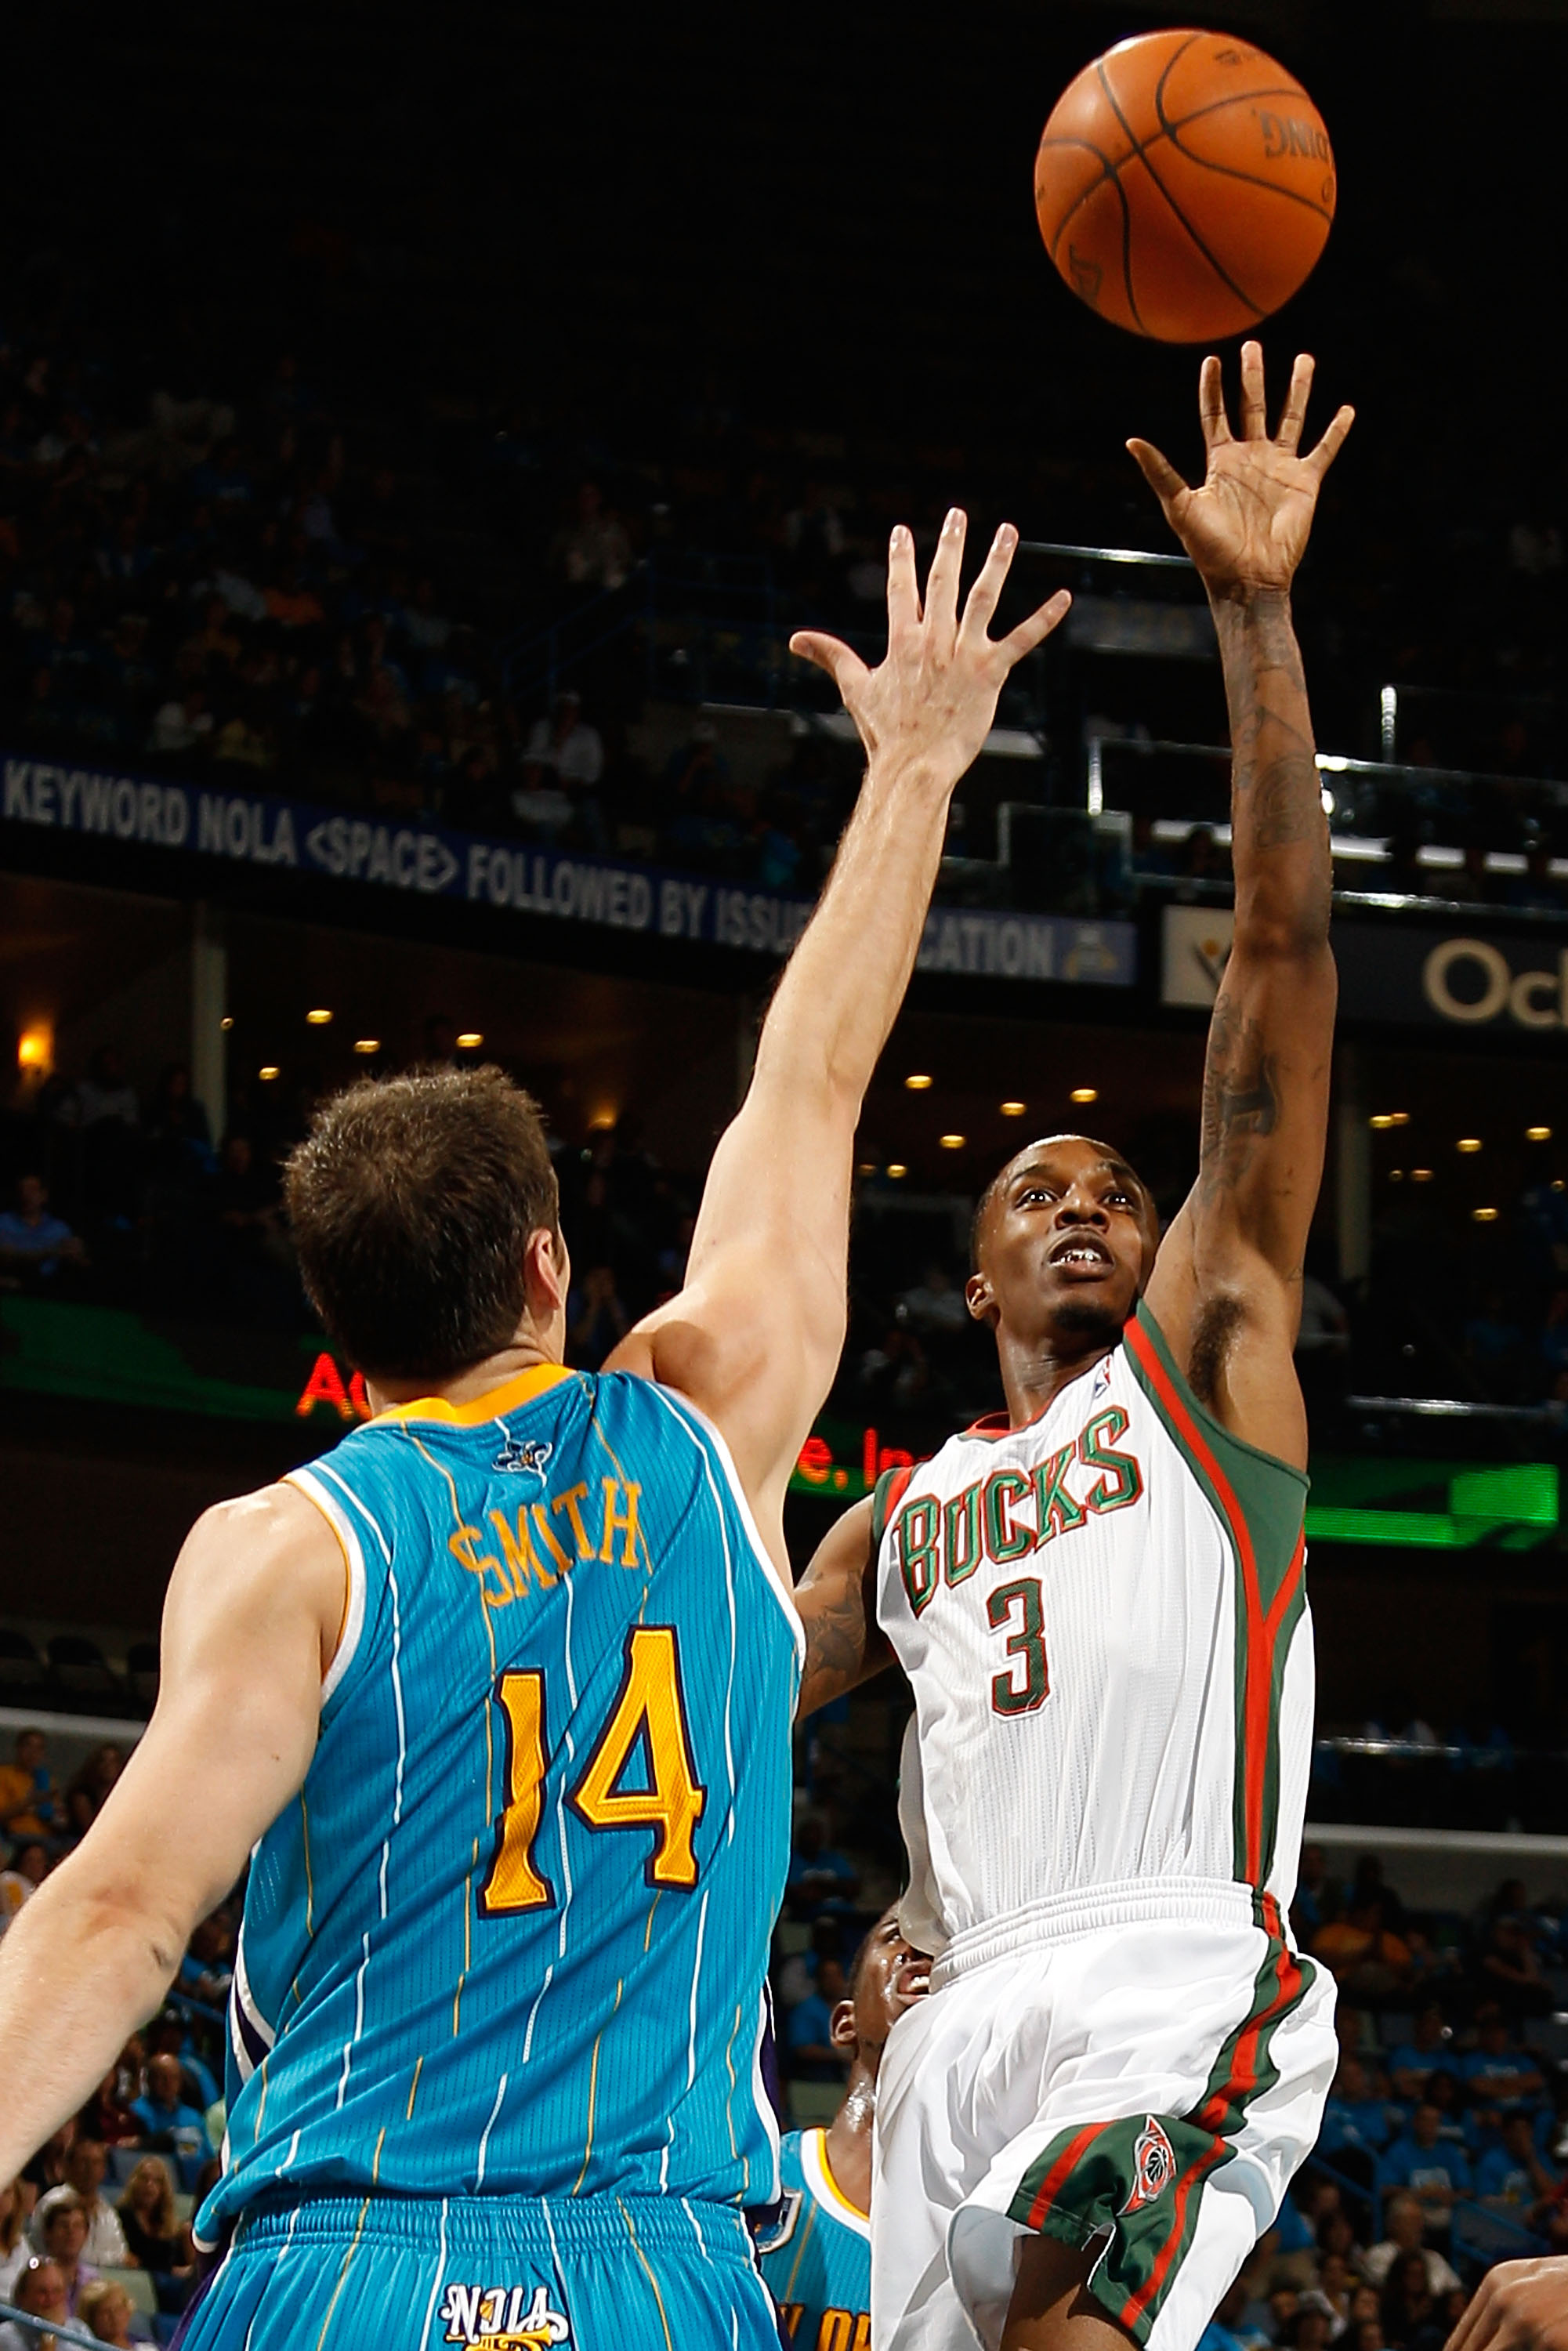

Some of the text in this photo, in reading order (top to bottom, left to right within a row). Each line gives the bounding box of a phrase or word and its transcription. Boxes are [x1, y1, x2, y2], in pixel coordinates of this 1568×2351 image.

[2, 758, 190, 848] KEYWORD
[197, 792, 299, 868] NOLA
[467, 843, 652, 932] FOLLOWED
[658, 878, 708, 941] BY
[448, 1476, 643, 1608] SMITH
[893, 1405, 1143, 1618] BUCKS
[986, 1577, 1050, 1718] 3
[476, 1624, 708, 1920] 14
[439, 2281, 570, 2346] NOLA
